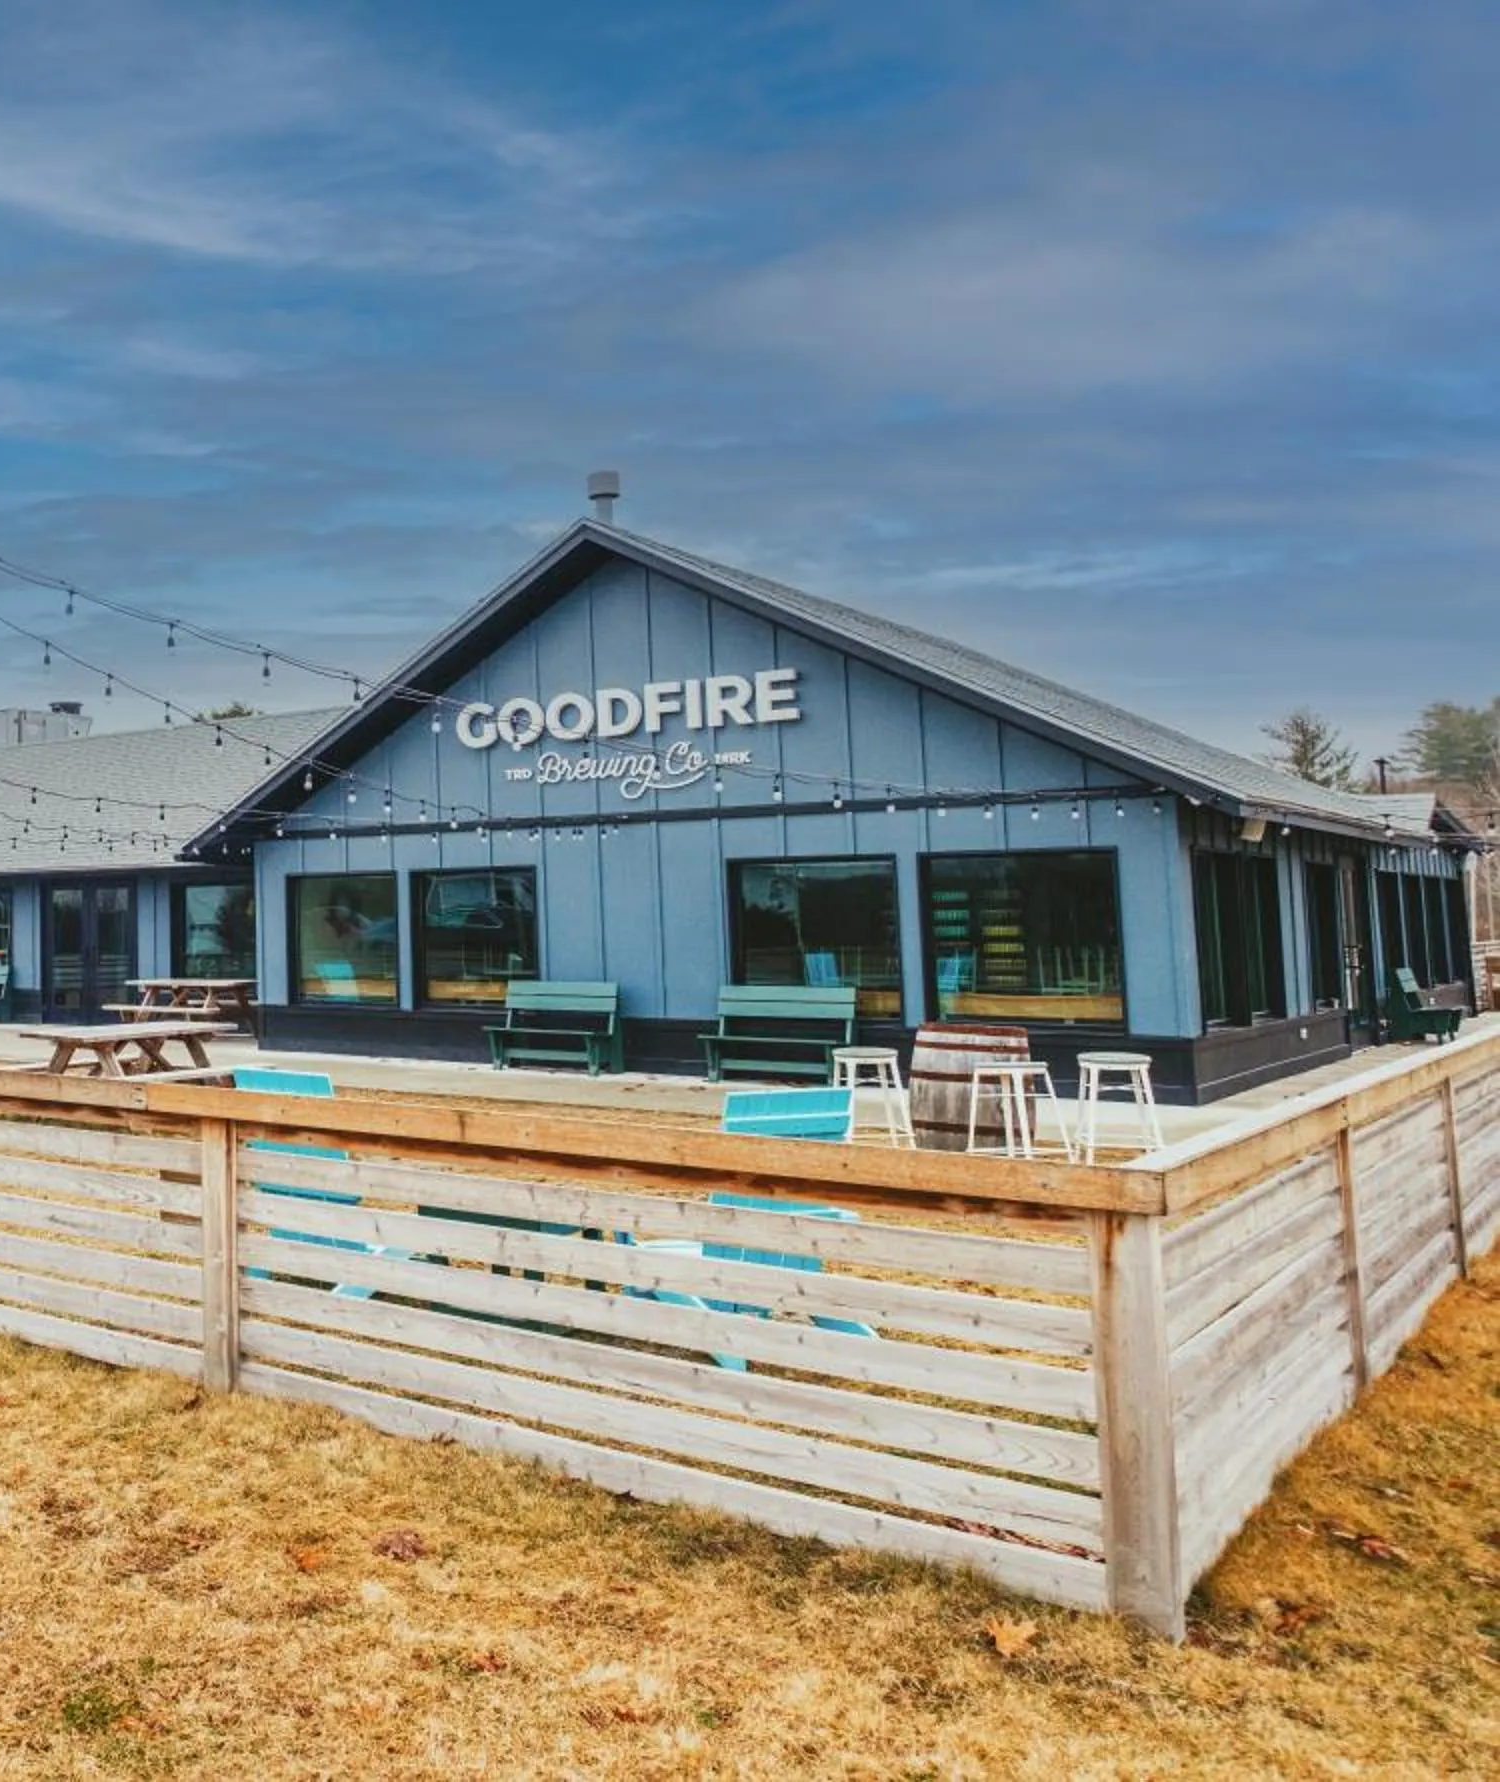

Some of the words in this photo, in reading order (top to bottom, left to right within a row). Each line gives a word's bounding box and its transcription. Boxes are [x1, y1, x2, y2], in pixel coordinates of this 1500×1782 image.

[456, 668, 801, 749] GOODFIRE
[503, 768, 532, 781] TRD
[537, 752, 705, 799] Brewing
